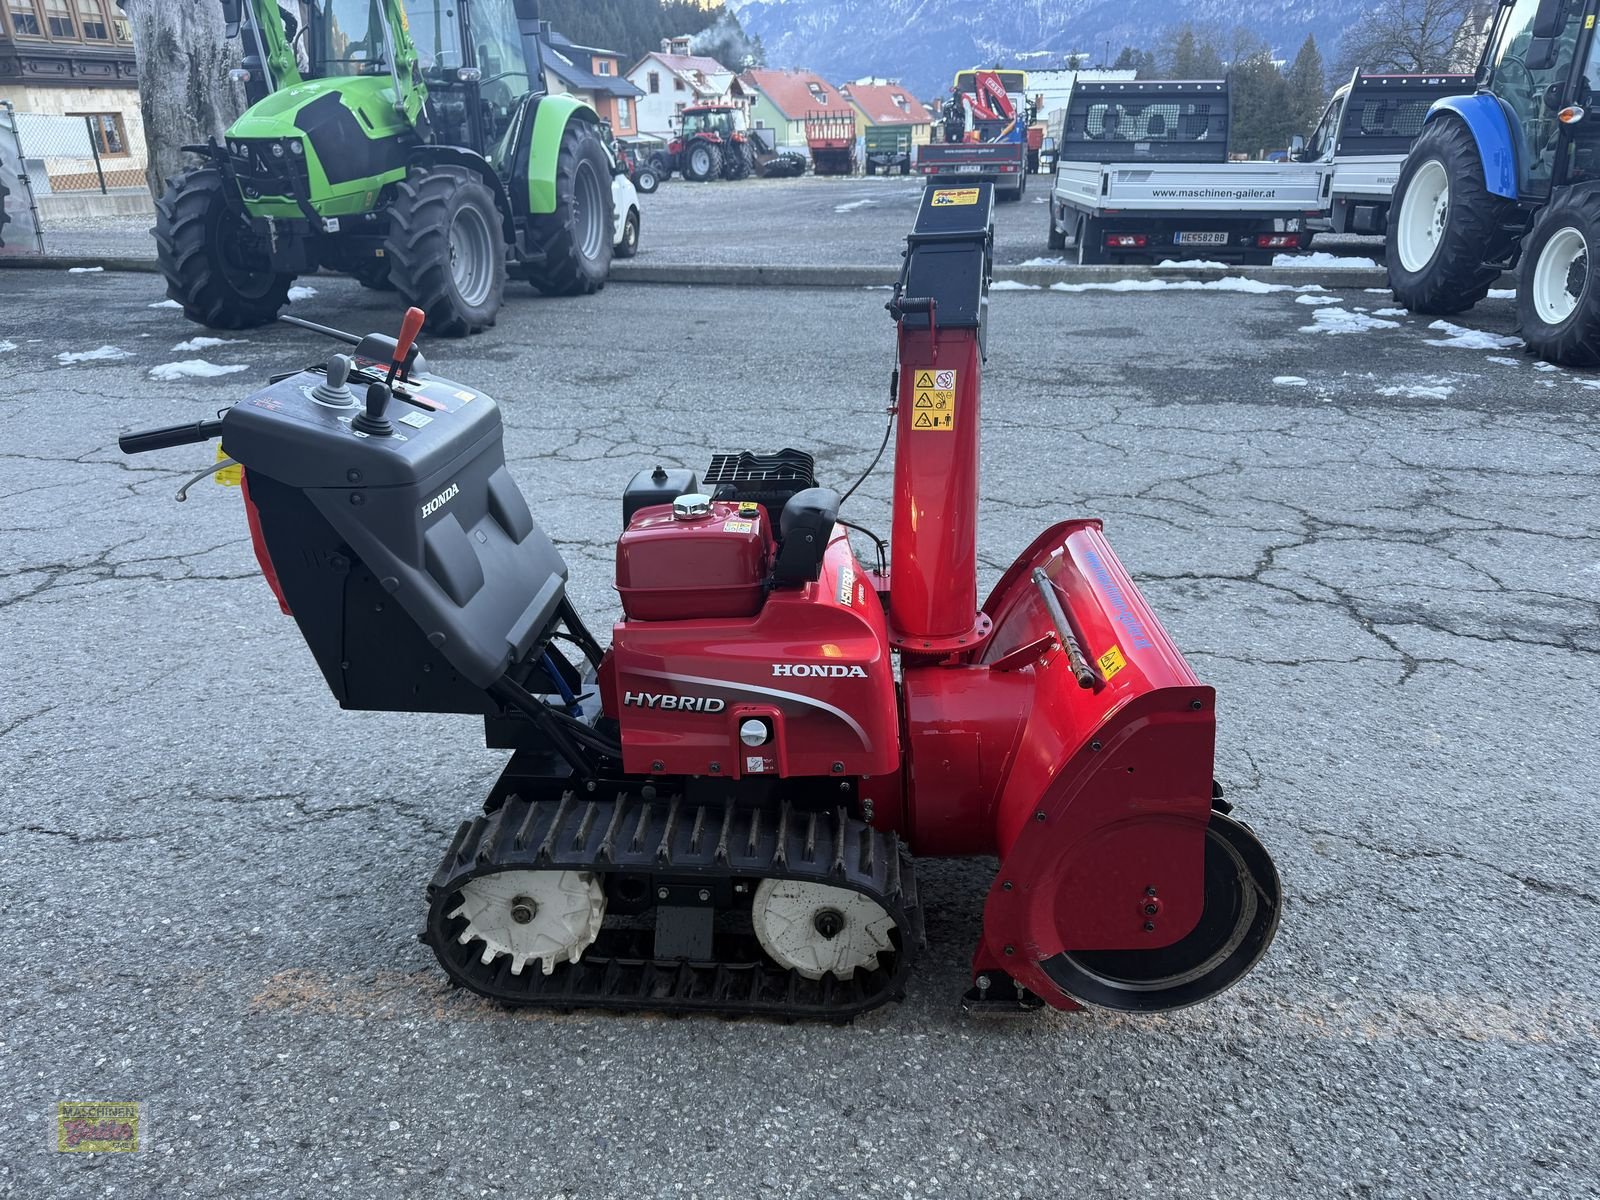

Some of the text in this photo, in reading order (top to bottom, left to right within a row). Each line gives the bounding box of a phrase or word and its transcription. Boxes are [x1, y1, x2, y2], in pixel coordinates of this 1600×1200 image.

[1152, 188, 1276, 200] www.maschinen-gailer.at
[1181, 233, 1192, 242] HE
[421, 483, 460, 519] HONDA
[772, 664, 868, 678] HONDA
[623, 691, 725, 713] HYBRID
